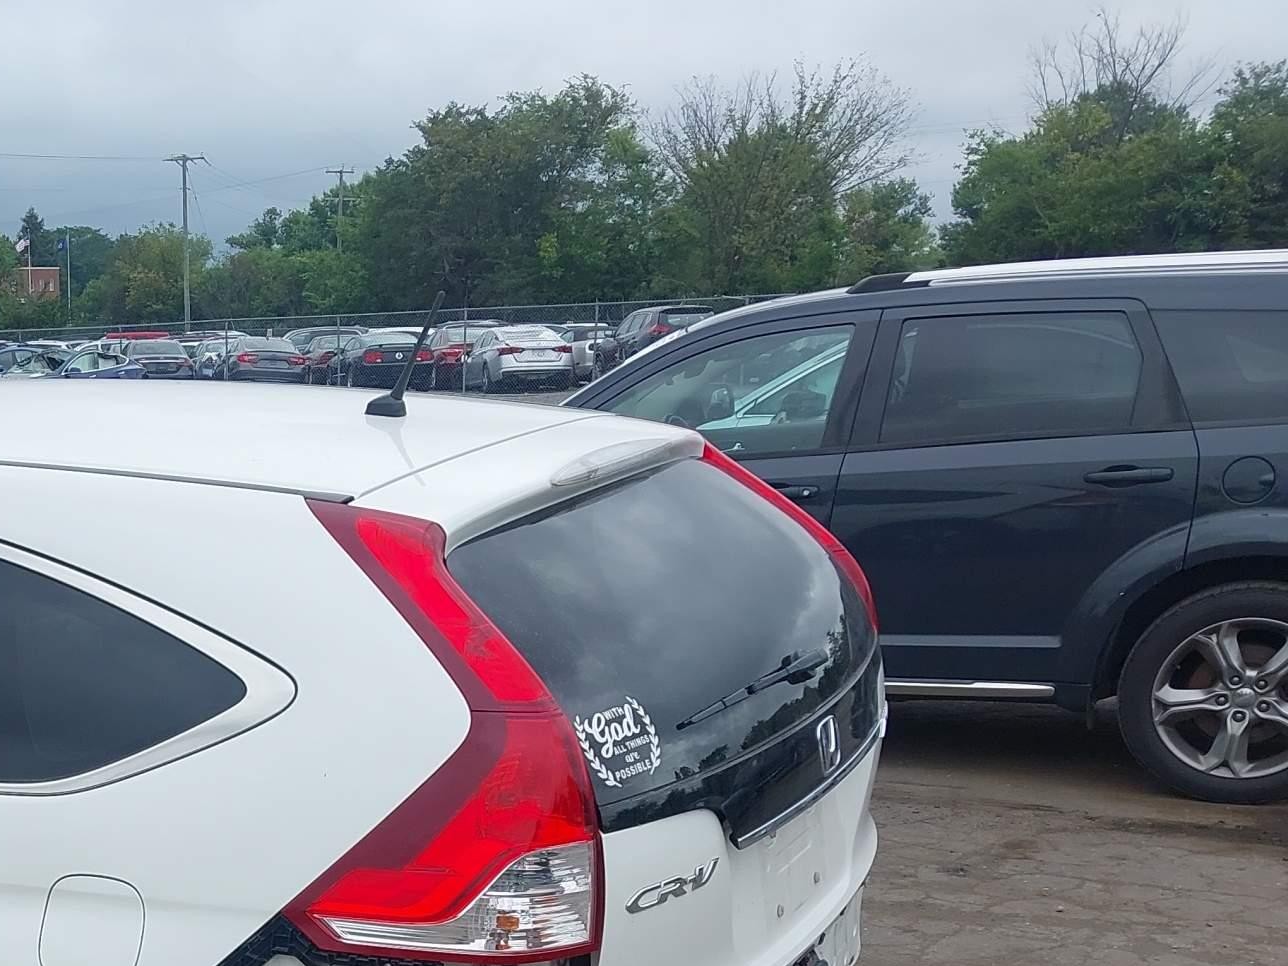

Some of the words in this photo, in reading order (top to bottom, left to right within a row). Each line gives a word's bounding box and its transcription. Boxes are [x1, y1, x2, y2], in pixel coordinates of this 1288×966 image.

[602, 706, 624, 721] WITH
[584, 703, 641, 759] God
[613, 744, 627, 756] ALL
[625, 734, 650, 750] THINGS
[624, 751, 641, 763] are
[614, 759, 652, 781] POSSIBLE
